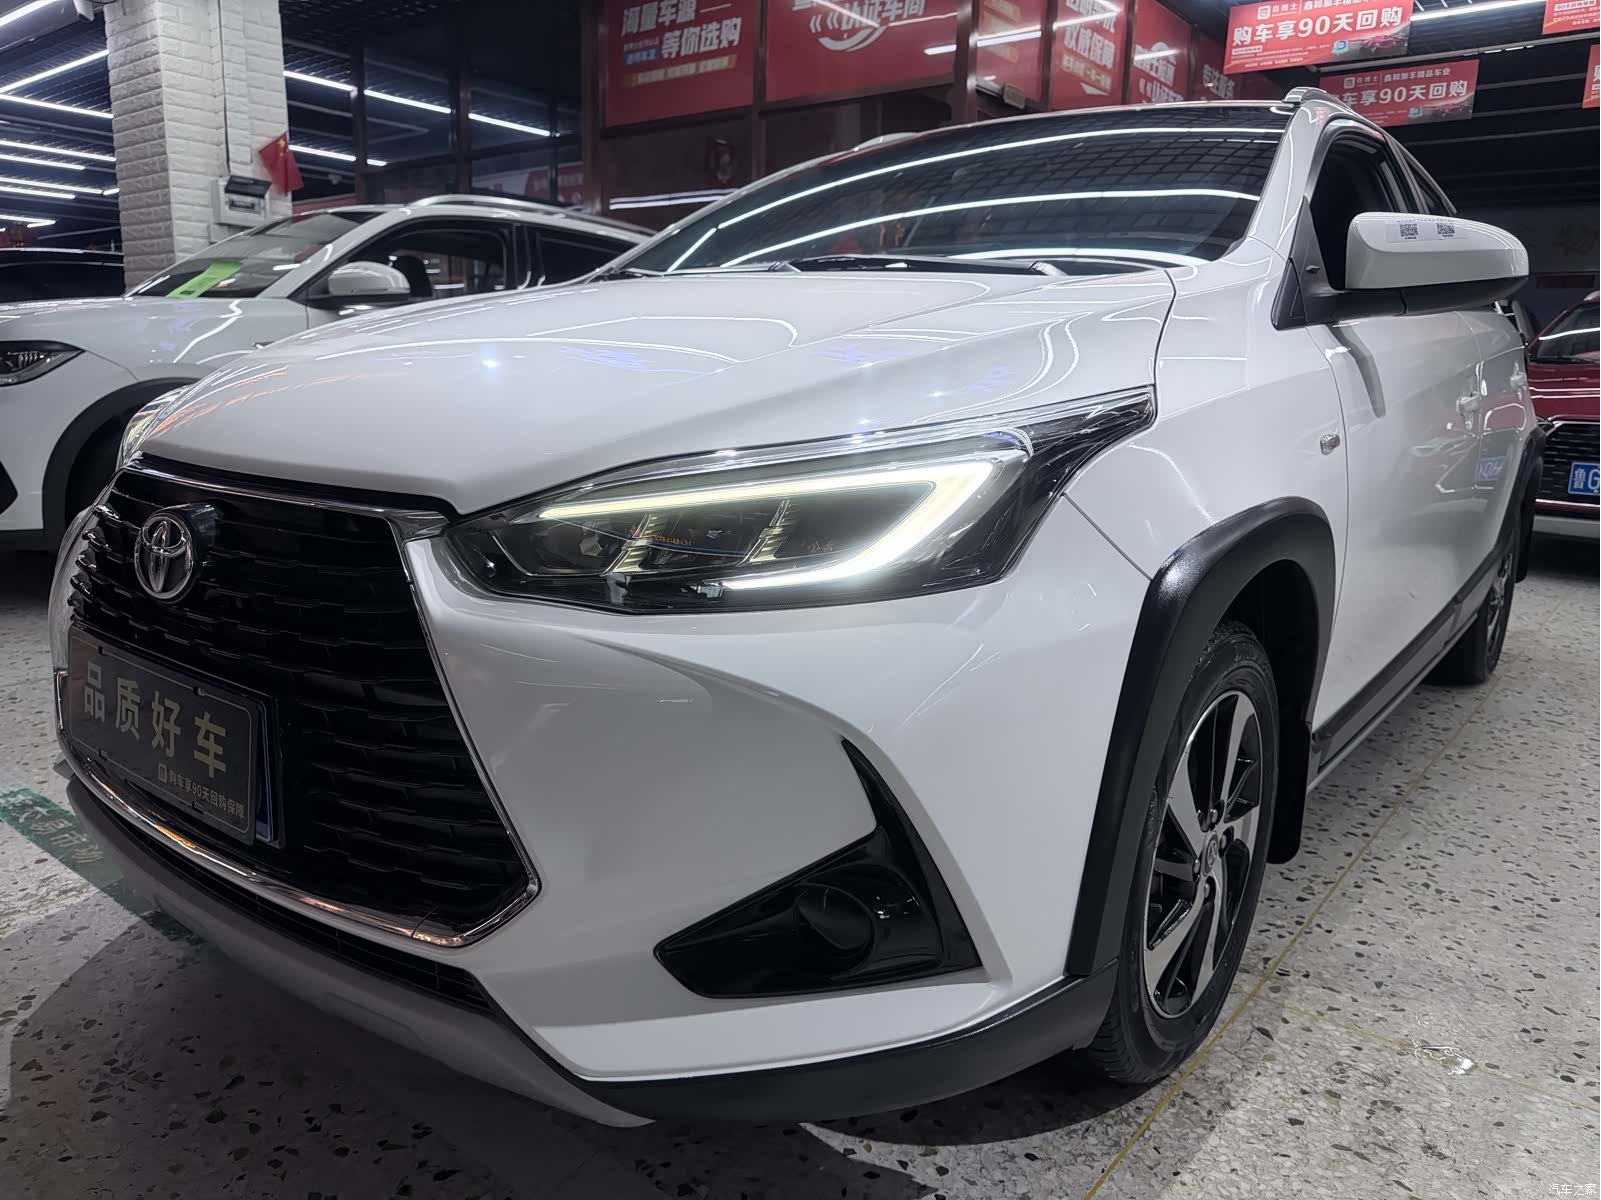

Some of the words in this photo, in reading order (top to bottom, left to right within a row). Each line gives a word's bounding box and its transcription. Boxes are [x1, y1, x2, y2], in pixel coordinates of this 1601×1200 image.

[661, 16, 742, 59] 等你选购
[1232, 6, 1403, 47] 购车享90天回购
[84, 661, 226, 779] 品质好车
[169, 769, 245, 819] 购车享90天回购保障
